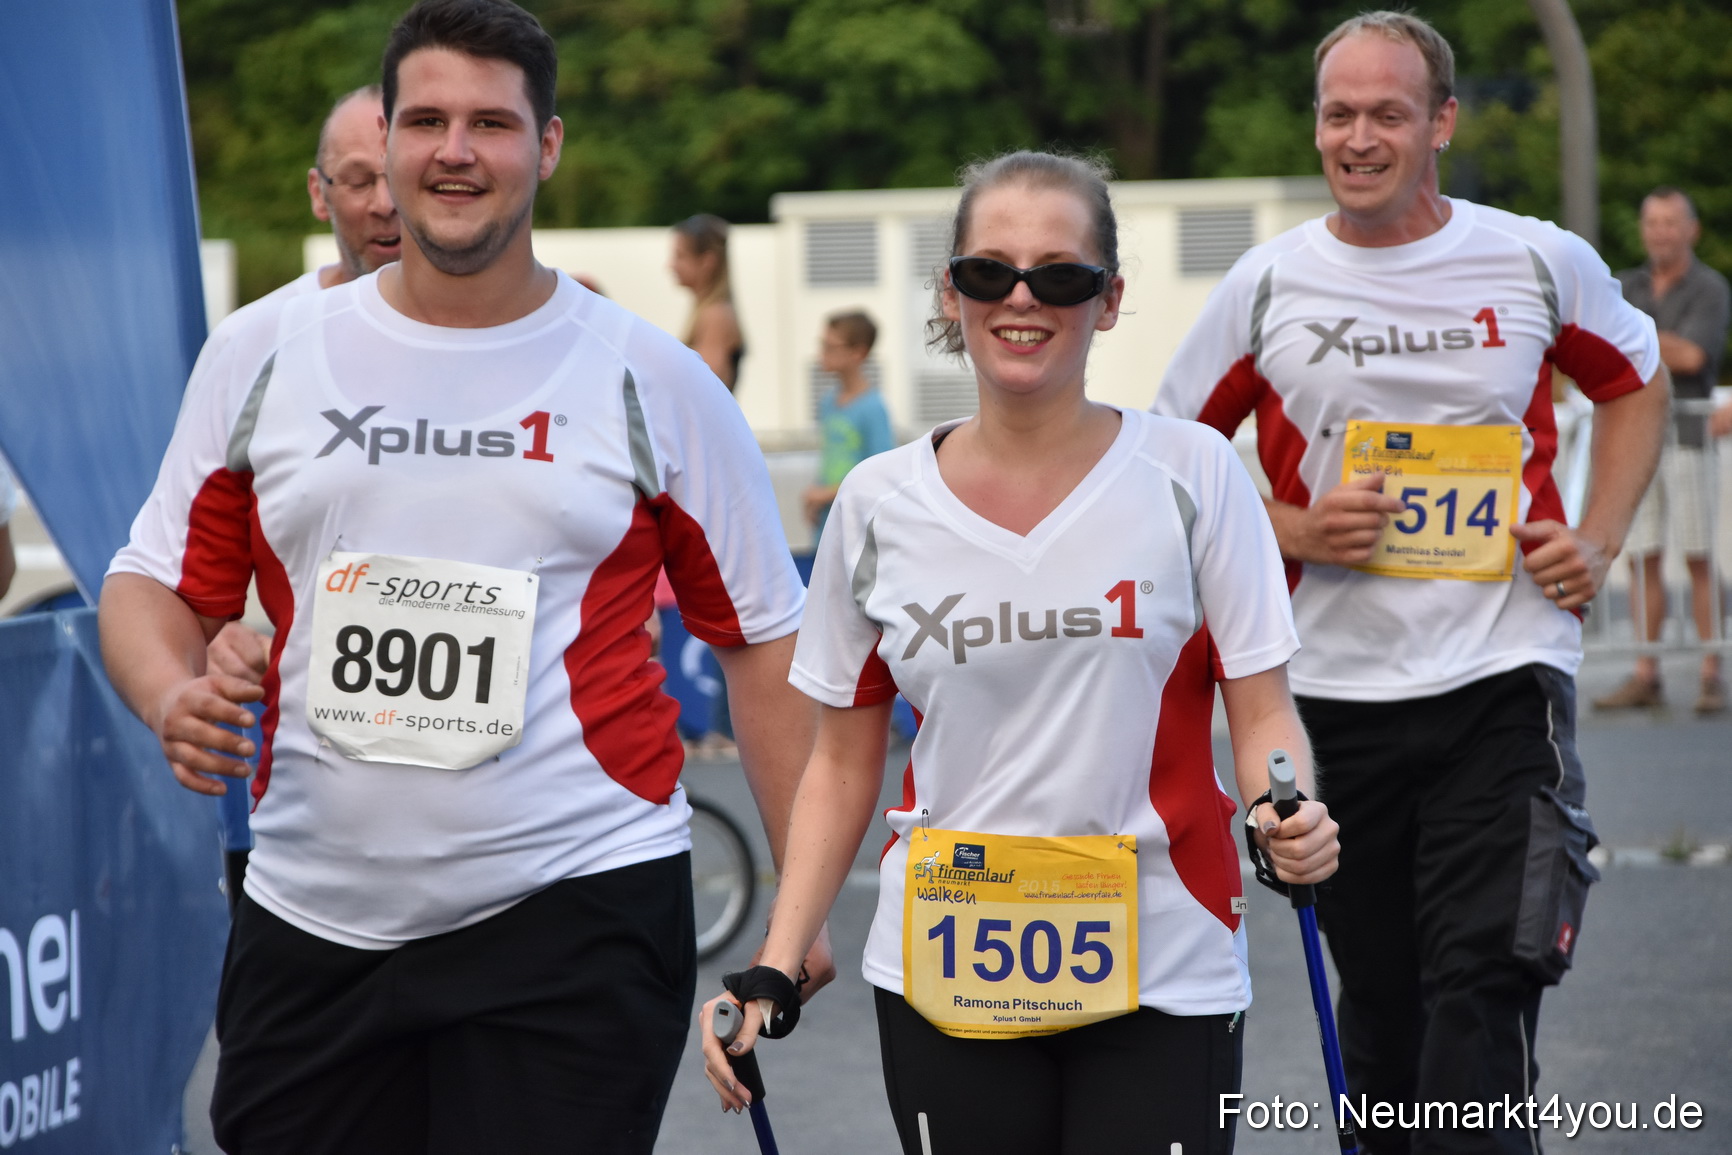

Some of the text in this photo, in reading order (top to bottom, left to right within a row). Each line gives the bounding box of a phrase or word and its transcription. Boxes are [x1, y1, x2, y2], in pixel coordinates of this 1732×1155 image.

[1377, 485, 1500, 536] 514
[325, 562, 502, 606] df-sports
[378, 596, 526, 619] die moderne Zeitmessung
[332, 624, 496, 704] 8901
[314, 707, 513, 736] www.df-sports.de
[938, 864, 1016, 883] firmenlauf
[1018, 880, 1061, 893] 2015
[917, 886, 976, 905] walken
[928, 915, 1114, 984] 1505
[953, 995, 1083, 1011] Ramona Pitschuch
[993, 1015, 1017, 1023] Xplus1
[0, 1056, 80, 1149] OBILE
